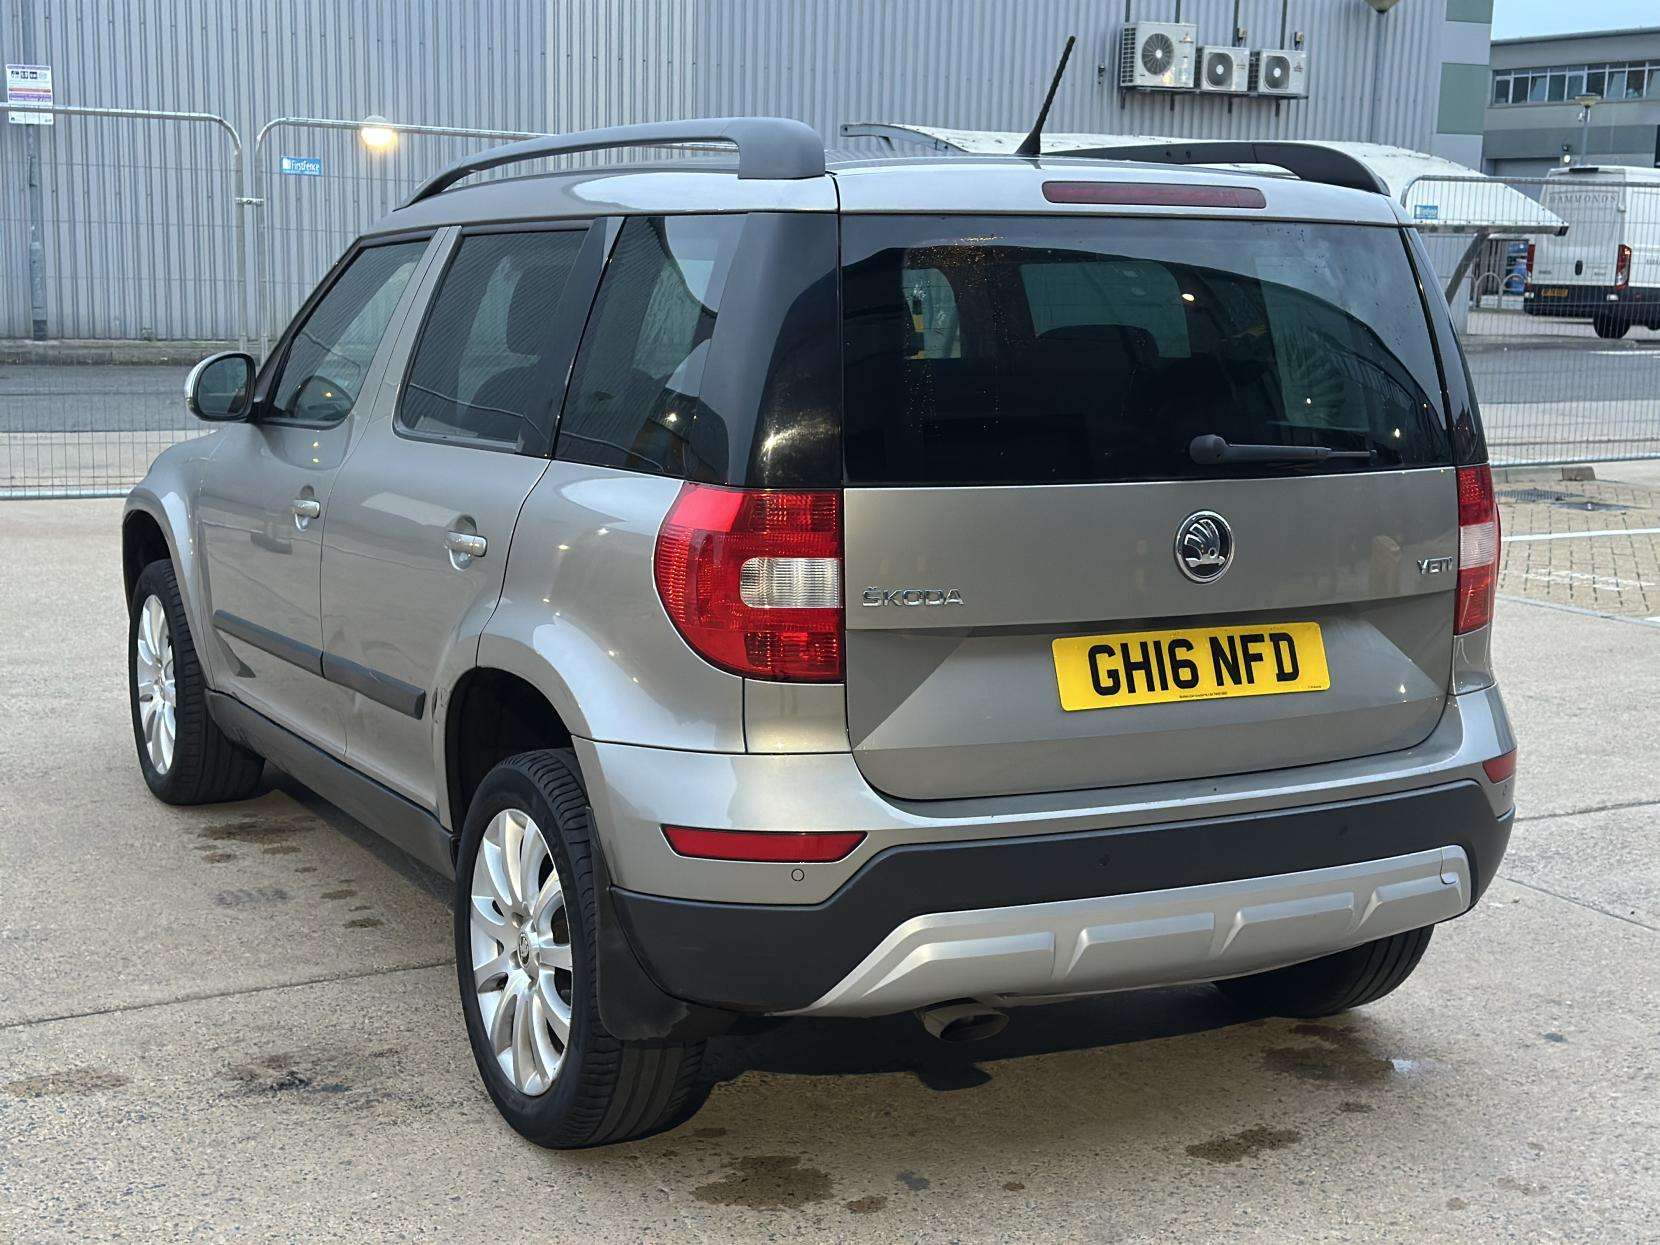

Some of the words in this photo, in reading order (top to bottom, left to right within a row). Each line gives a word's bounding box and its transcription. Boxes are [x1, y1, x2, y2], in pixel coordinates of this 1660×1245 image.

[862, 586, 964, 607] ŠKODA
[1088, 638, 1200, 696] GH16
[1209, 632, 1300, 687] NFD
